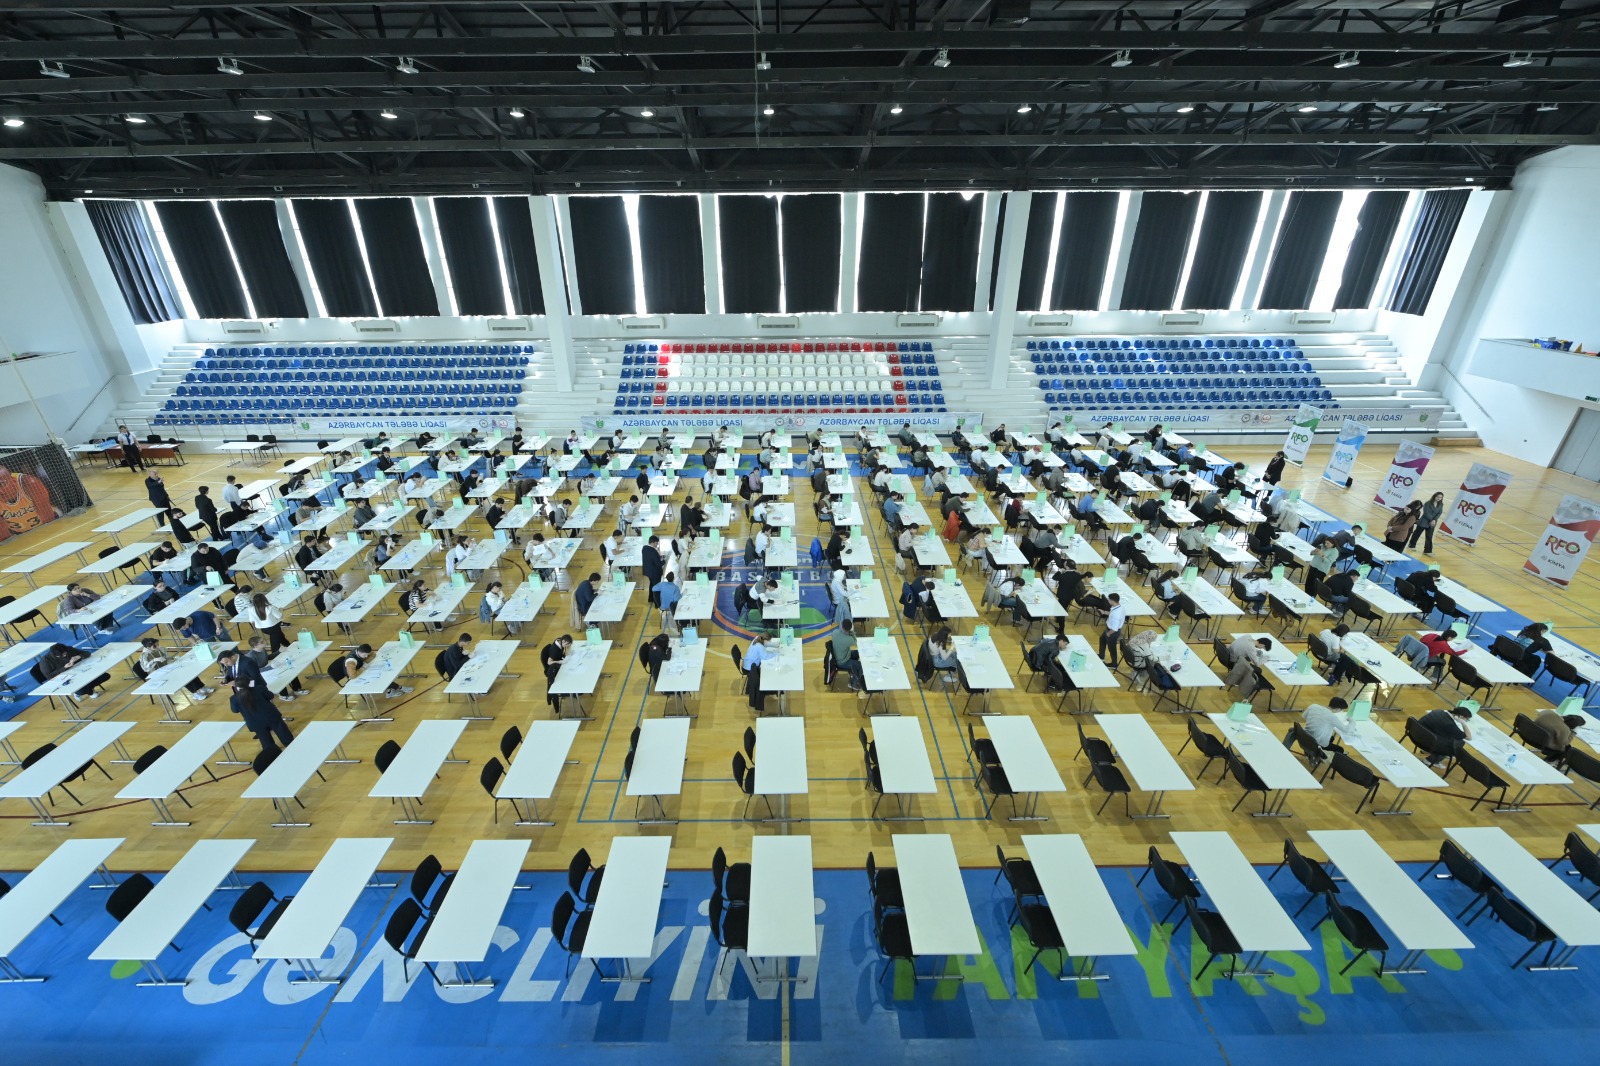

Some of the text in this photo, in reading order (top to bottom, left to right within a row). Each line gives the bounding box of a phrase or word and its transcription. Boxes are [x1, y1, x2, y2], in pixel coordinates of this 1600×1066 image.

[622, 418, 743, 427] AZƏRBAYCAN TƏLƏBƏ LİQASI
[819, 418, 875, 426] AZƏRBAYCAN
[912, 417, 940, 425] LİQASI
[1182, 413, 1210, 423] LİQASI
[1375, 413, 1403, 422] LİQASI
[328, 421, 384, 429] AZƏRBAYCAN
[420, 420, 447, 428] LİQASI
[1291, 432, 1309, 445] RFO
[1389, 473, 1414, 488] RFO
[1457, 499, 1487, 517] RFO
[1545, 534, 1581, 556] RFO
